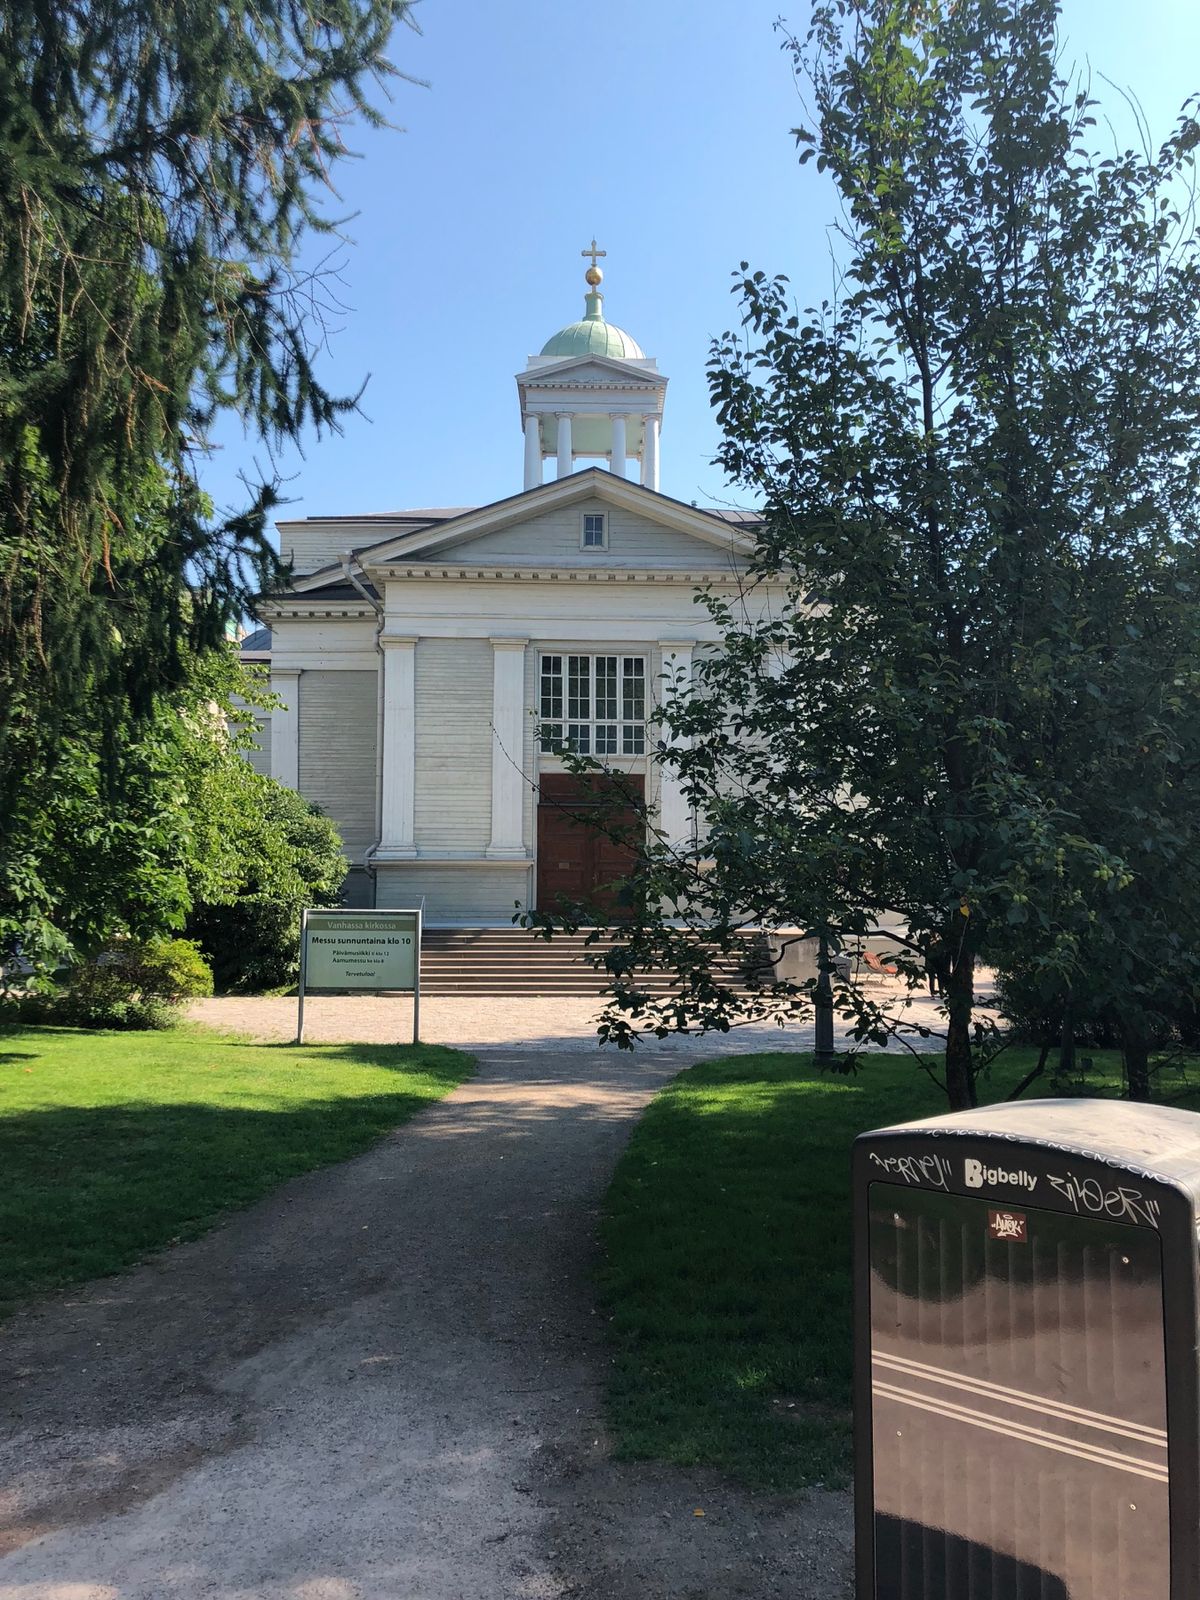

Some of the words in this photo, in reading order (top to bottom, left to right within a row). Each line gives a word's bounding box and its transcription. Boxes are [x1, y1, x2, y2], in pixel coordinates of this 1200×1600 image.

[327, 921, 364, 929] Vanhassa
[364, 921, 396, 930] kirkossa
[311, 936, 336, 944] Messu
[337, 936, 386, 945] sunnuntaina
[387, 937, 400, 945] klo
[964, 1158, 1038, 1191] Bigbelly
